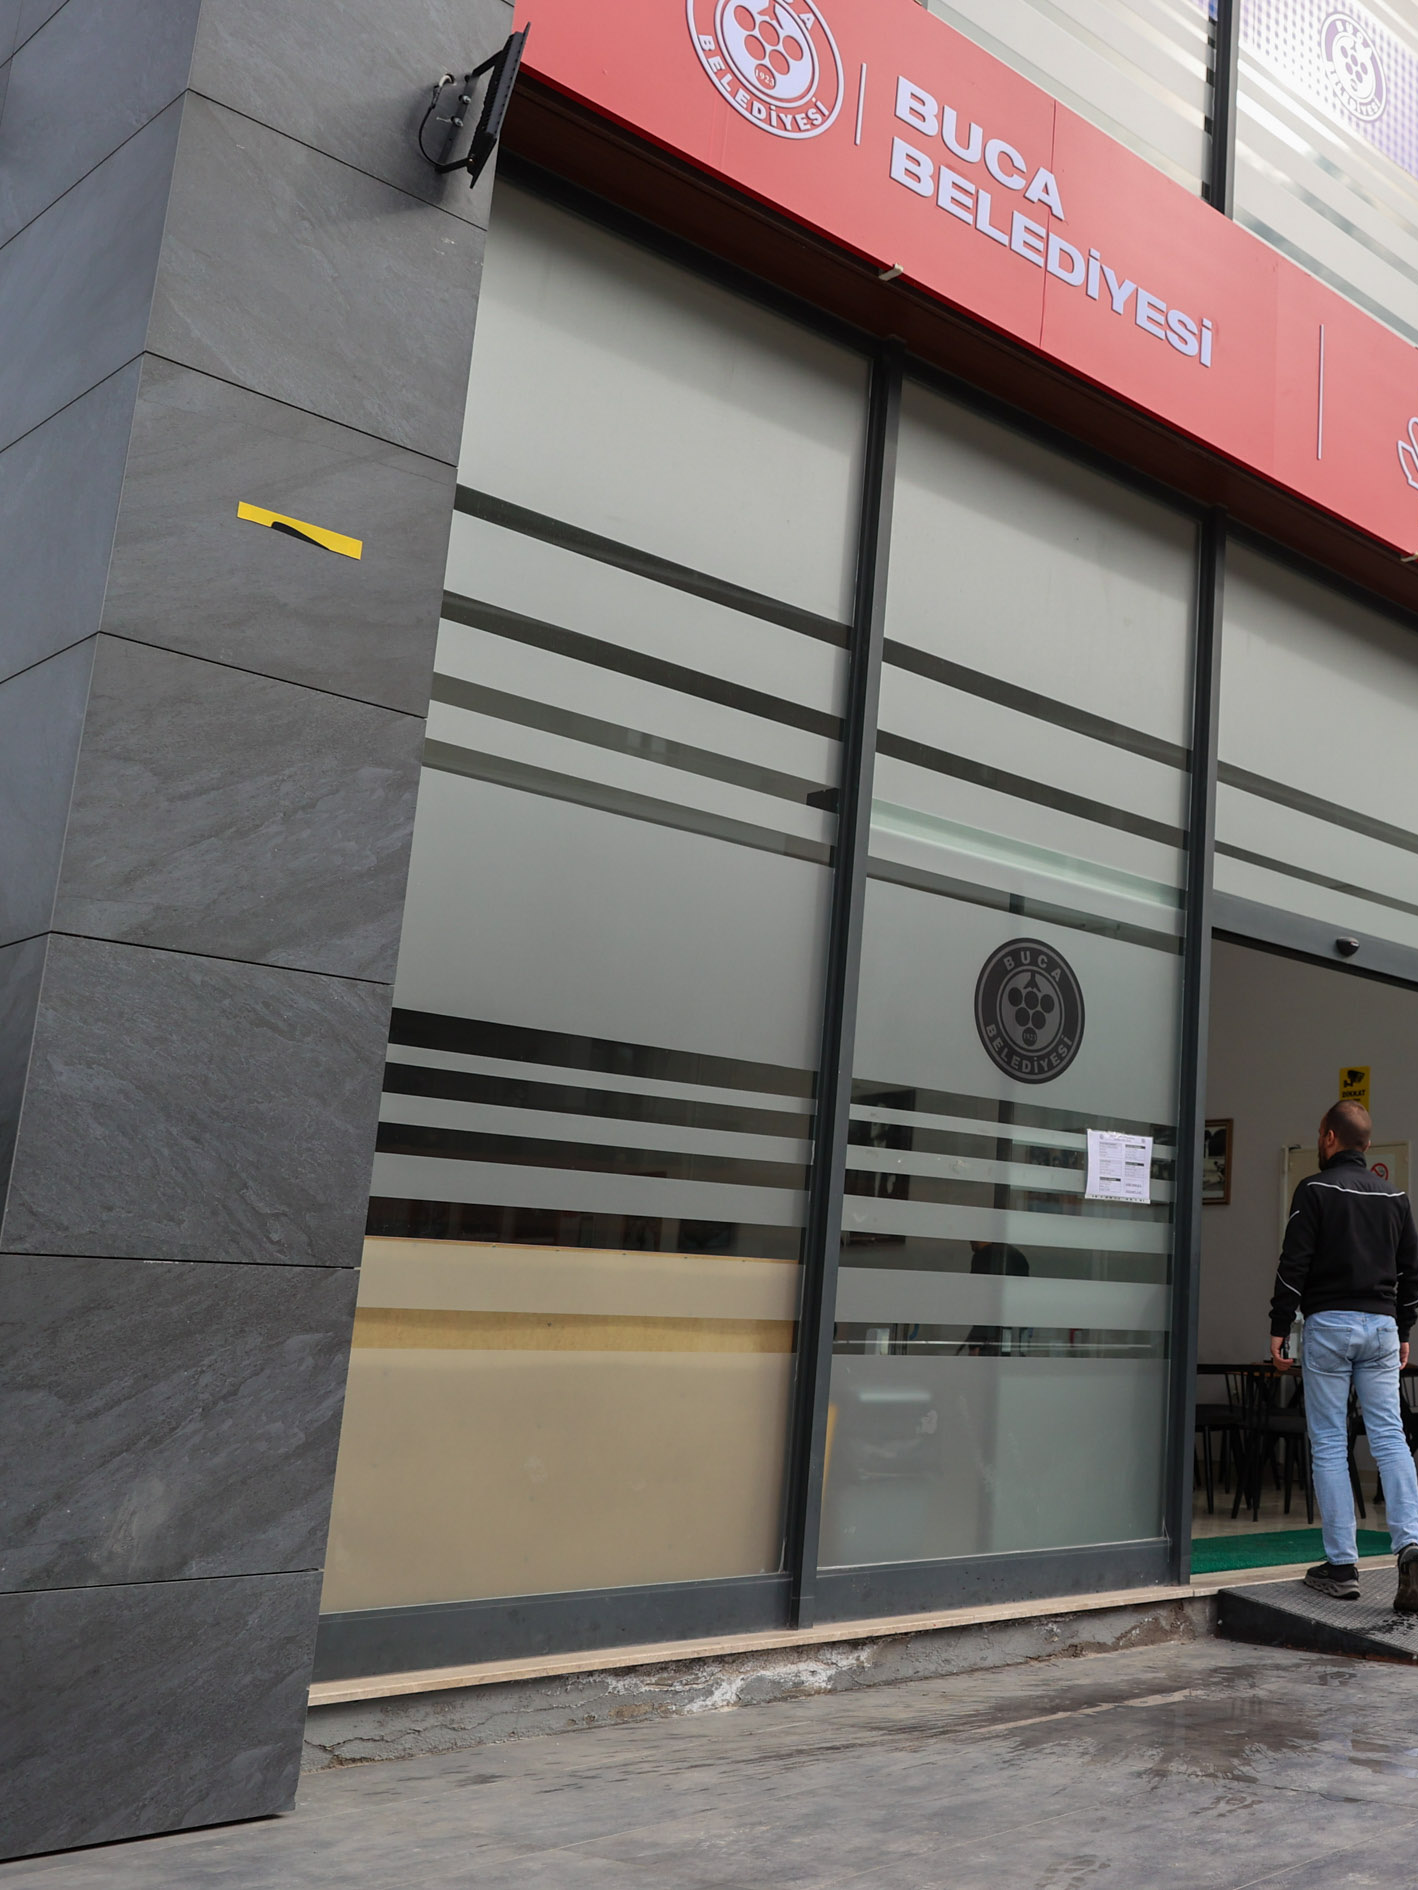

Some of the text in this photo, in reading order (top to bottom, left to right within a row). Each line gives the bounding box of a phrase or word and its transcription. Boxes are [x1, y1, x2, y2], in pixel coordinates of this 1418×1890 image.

[697, 34, 830, 132] BELEDİYESİ
[754, 69, 776, 87] 1923
[894, 75, 1065, 222] BUCA
[888, 136, 1213, 368] BELEDİYESİ
[1003, 951, 1062, 983] BUCA
[986, 1024, 1073, 1074] BELEDİYESİ
